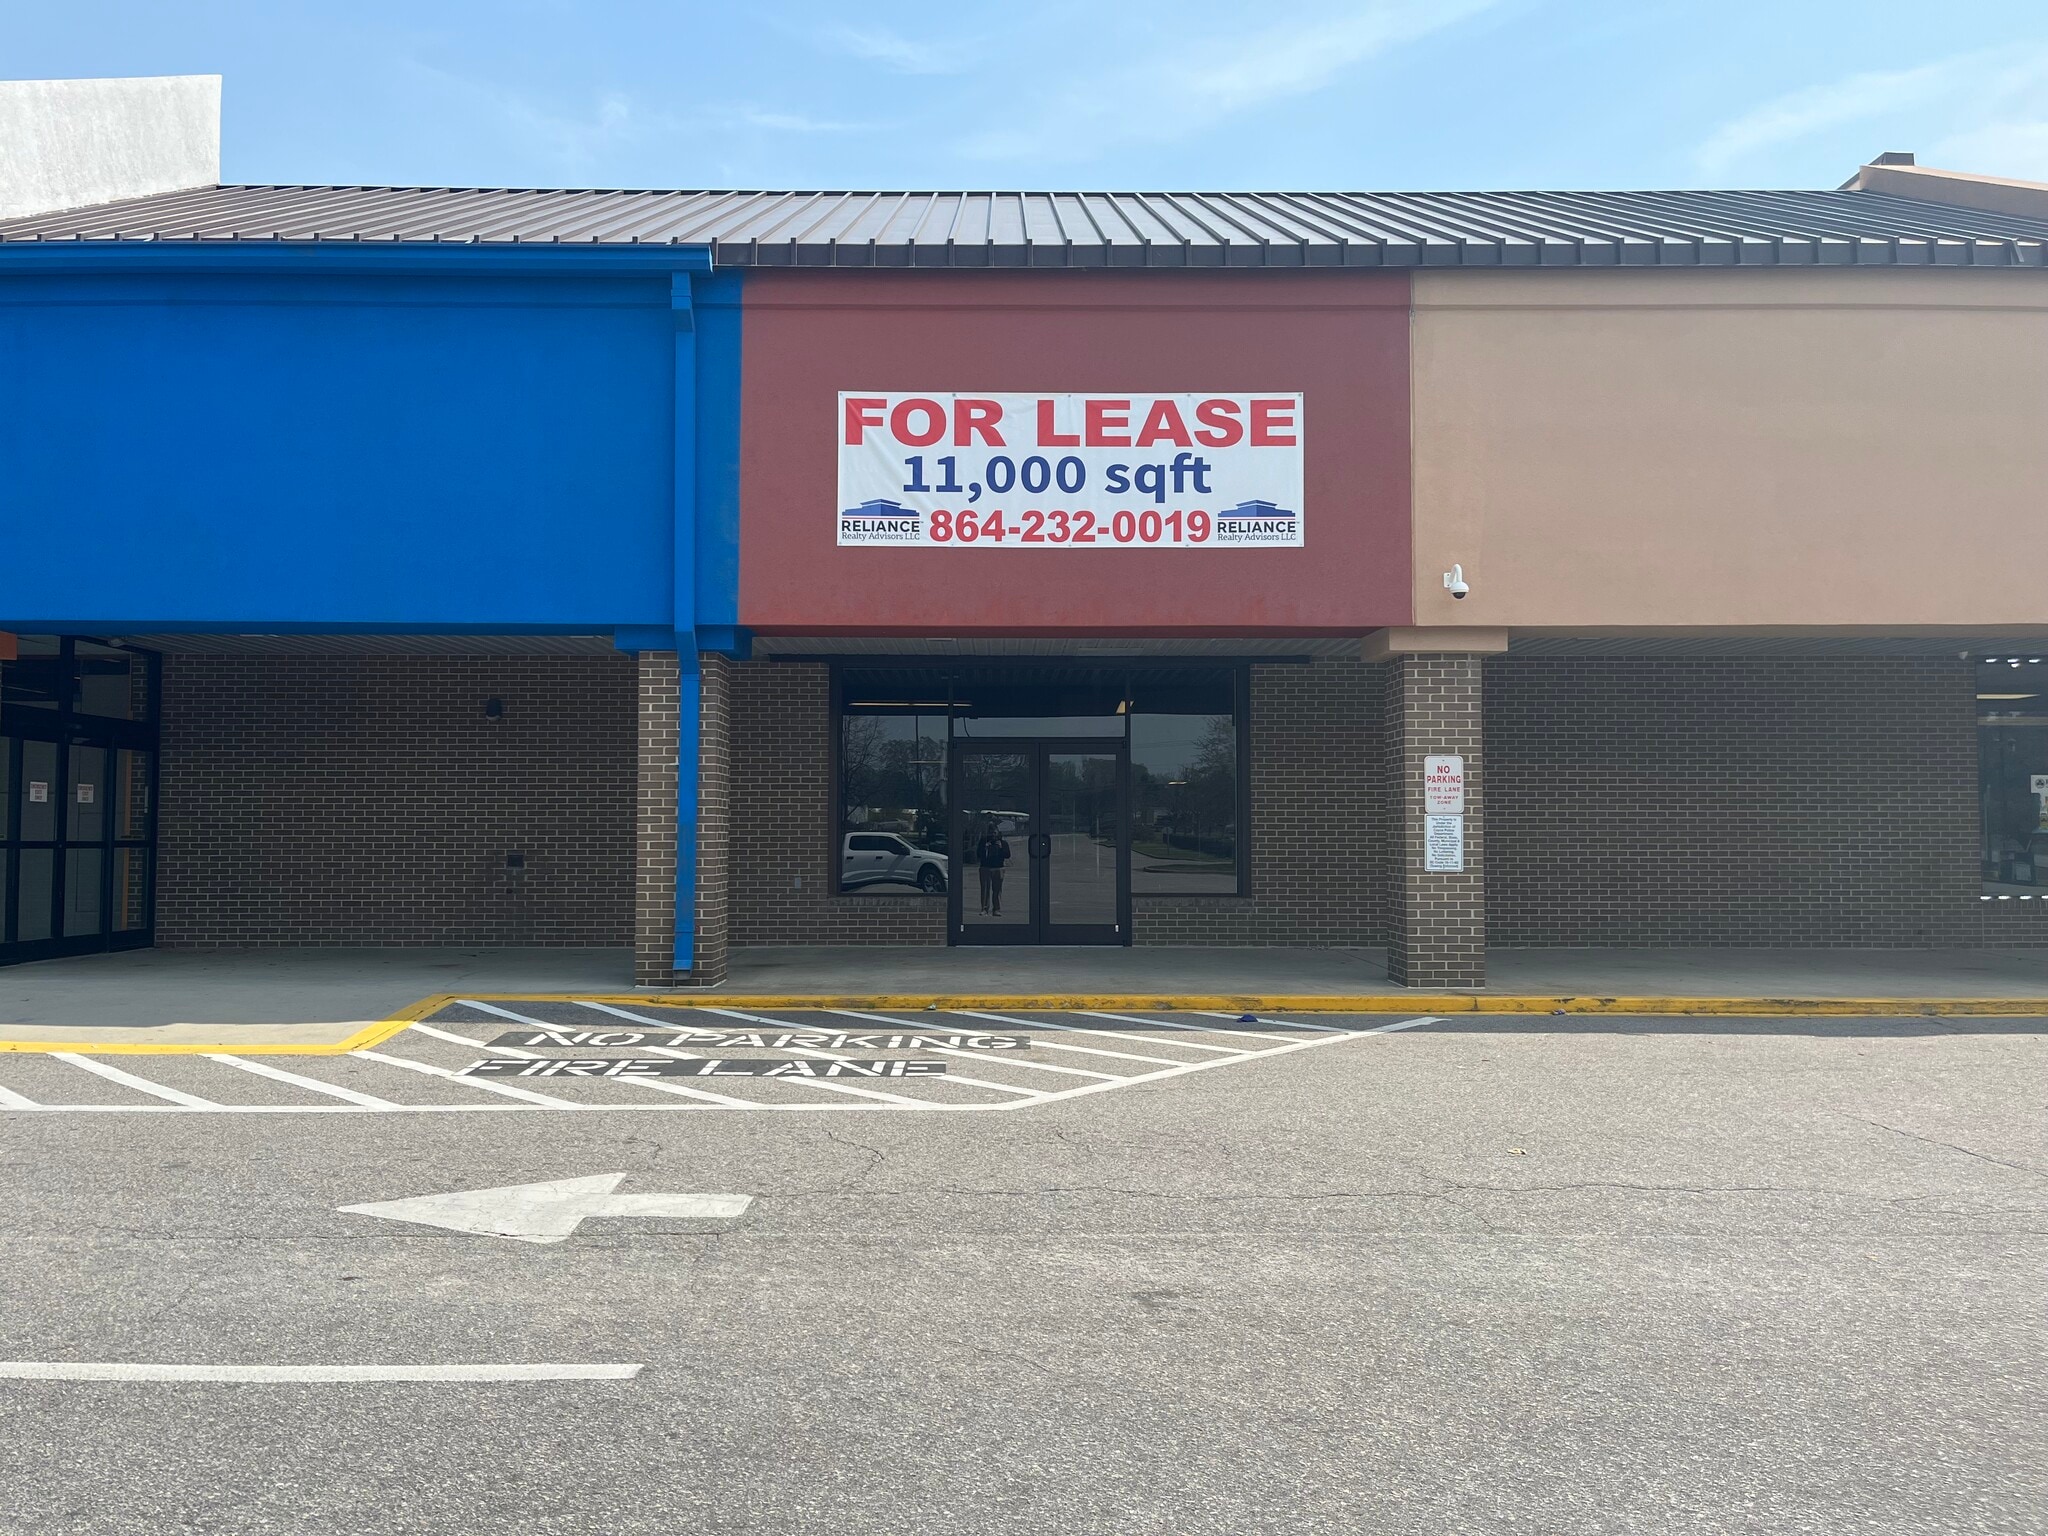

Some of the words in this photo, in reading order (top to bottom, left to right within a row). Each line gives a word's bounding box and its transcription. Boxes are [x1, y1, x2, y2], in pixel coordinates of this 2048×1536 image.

[844, 398, 1007, 447] FOR
[1037, 399, 1297, 447] LEASE
[903, 455, 1086, 503] 11,000
[1105, 452, 1212, 503] sqft
[842, 520, 920, 532] RELIANCE
[929, 510, 1211, 543] 864-232-0019
[1217, 521, 1296, 533] RELIANCE
[842, 532, 867, 541] Realty
[868, 532, 903, 541] Advisors
[905, 533, 920, 541] LLC
[1217, 534, 1244, 542] Realty
[1244, 533, 1279, 541] Advisors
[1281, 533, 1296, 541] LLC
[1437, 765, 1450, 774] NO
[1427, 776, 1461, 784] PARKING
[524, 1031, 645, 1047] NO
[666, 1032, 1018, 1049] PARKING
[452, 1059, 675, 1076] FIRE
[697, 1060, 946, 1077] LANE
